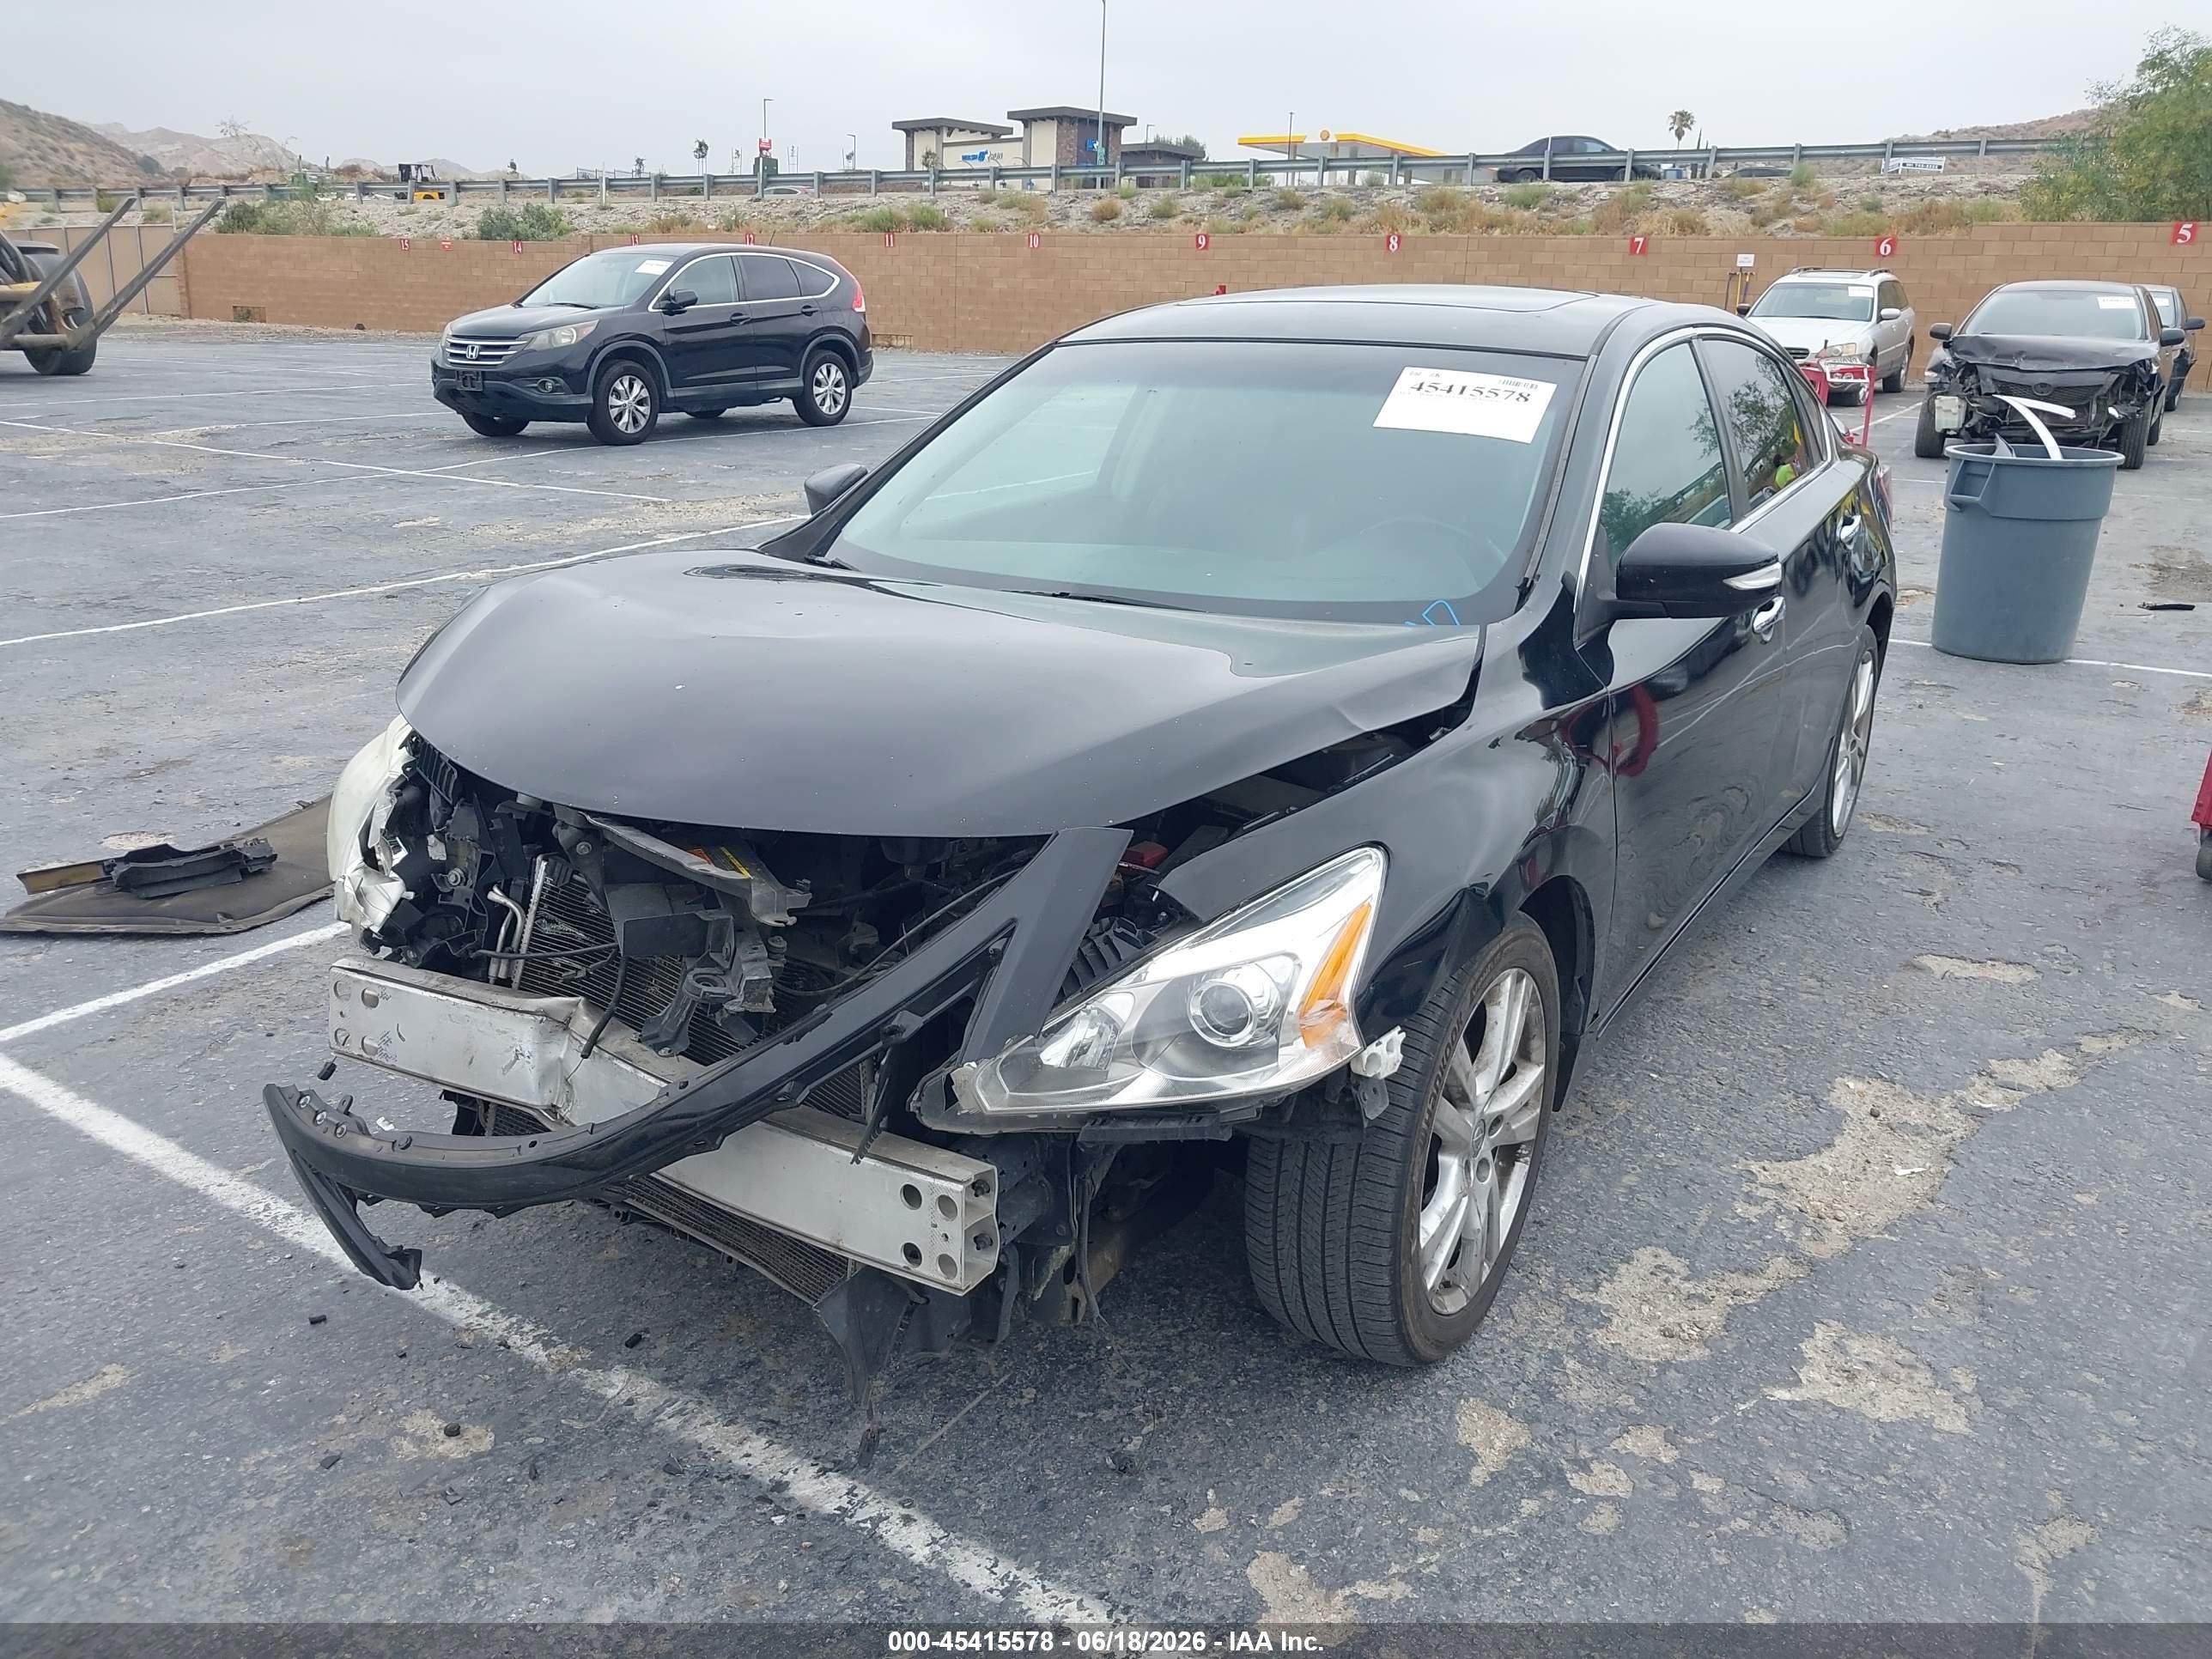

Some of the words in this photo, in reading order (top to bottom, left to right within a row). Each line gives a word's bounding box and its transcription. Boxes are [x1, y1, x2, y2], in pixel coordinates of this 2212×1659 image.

[1030, 233, 1039, 248] 10
[1198, 234, 1206, 250] 9
[2177, 223, 2193, 243] 5
[1389, 234, 1399, 252] 8
[1633, 237, 1644, 254] 7
[1880, 237, 1892, 256] 6
[1410, 381, 1531, 403] 45415578
